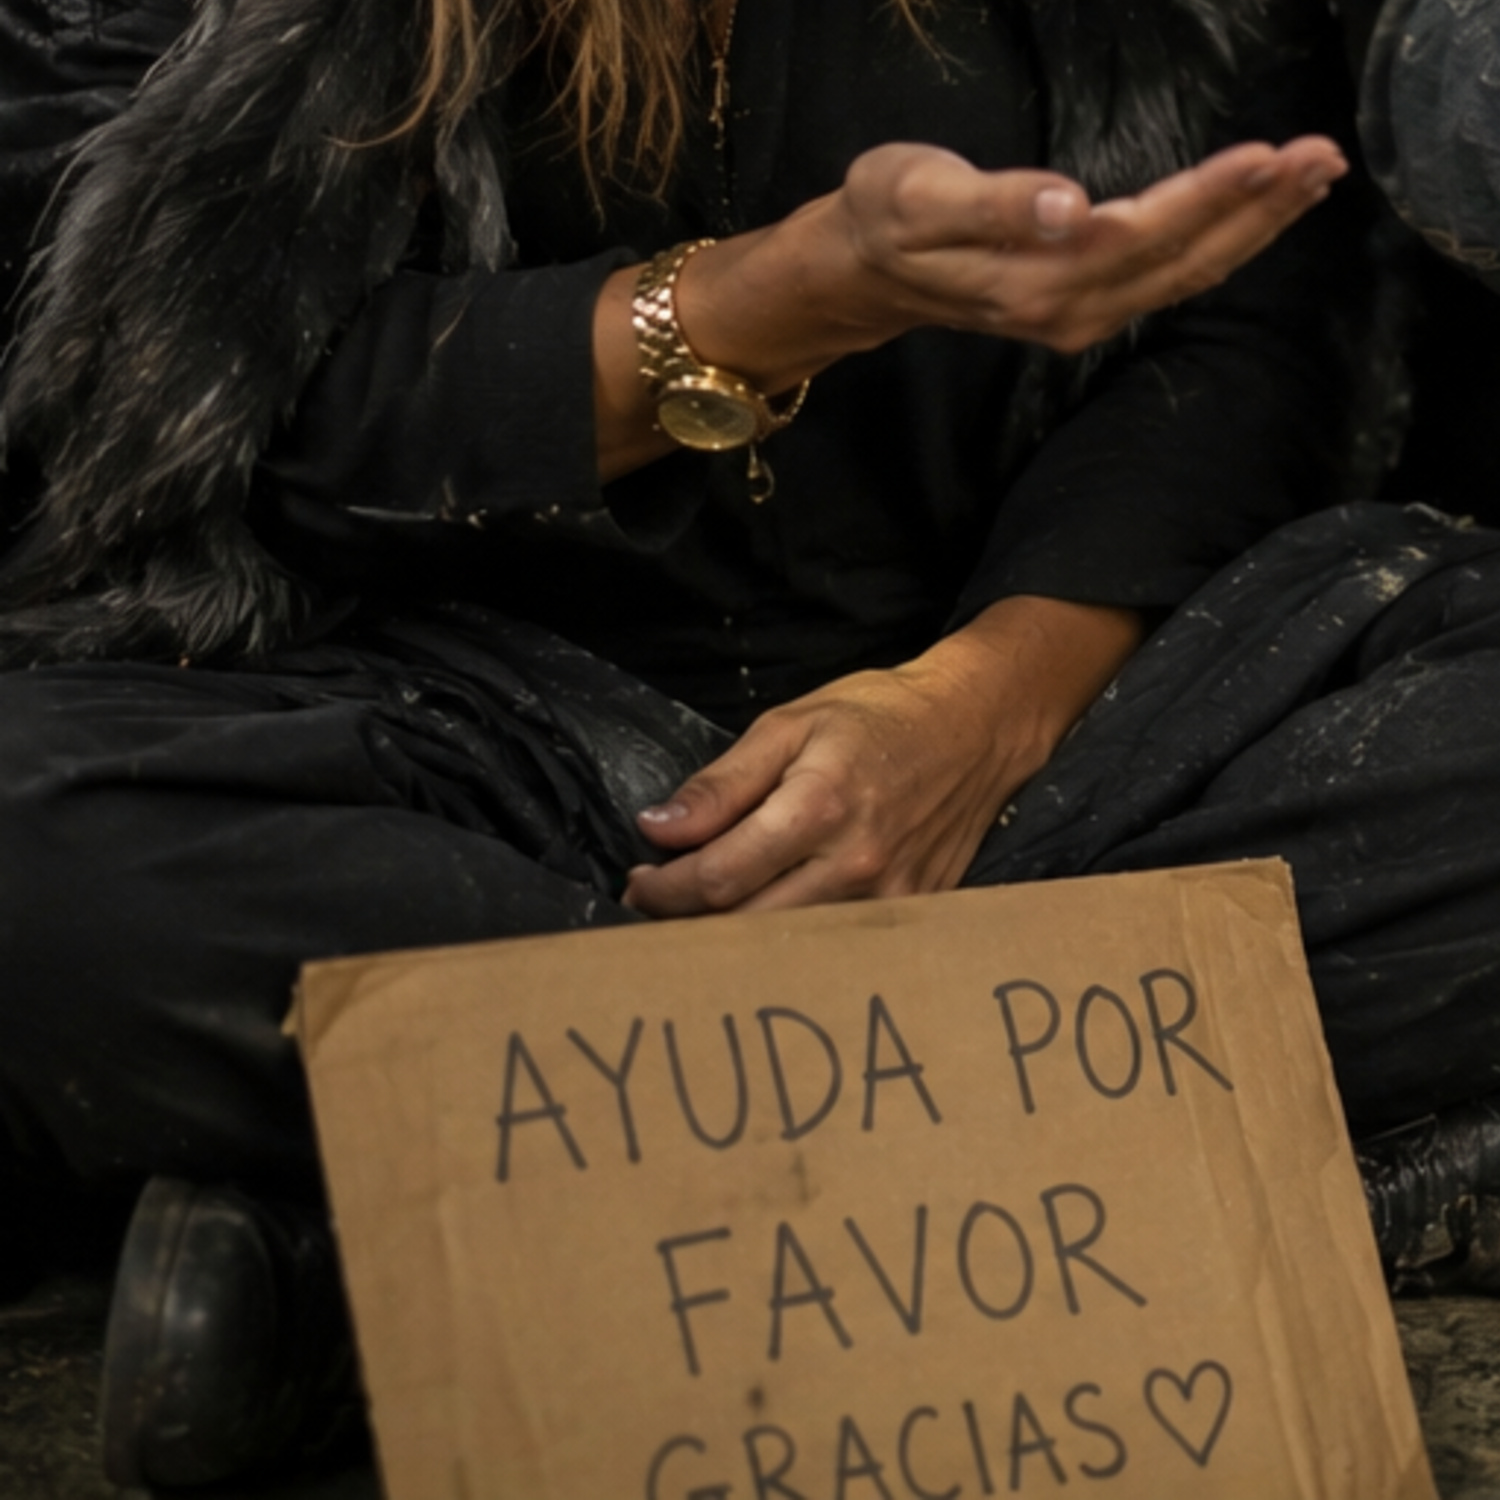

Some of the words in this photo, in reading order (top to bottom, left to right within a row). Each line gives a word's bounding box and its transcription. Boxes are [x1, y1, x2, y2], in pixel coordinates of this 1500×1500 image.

[495, 993, 943, 1184] AYUDA
[991, 967, 1235, 1116] POR
[655, 1182, 1148, 1376] FAVOR
